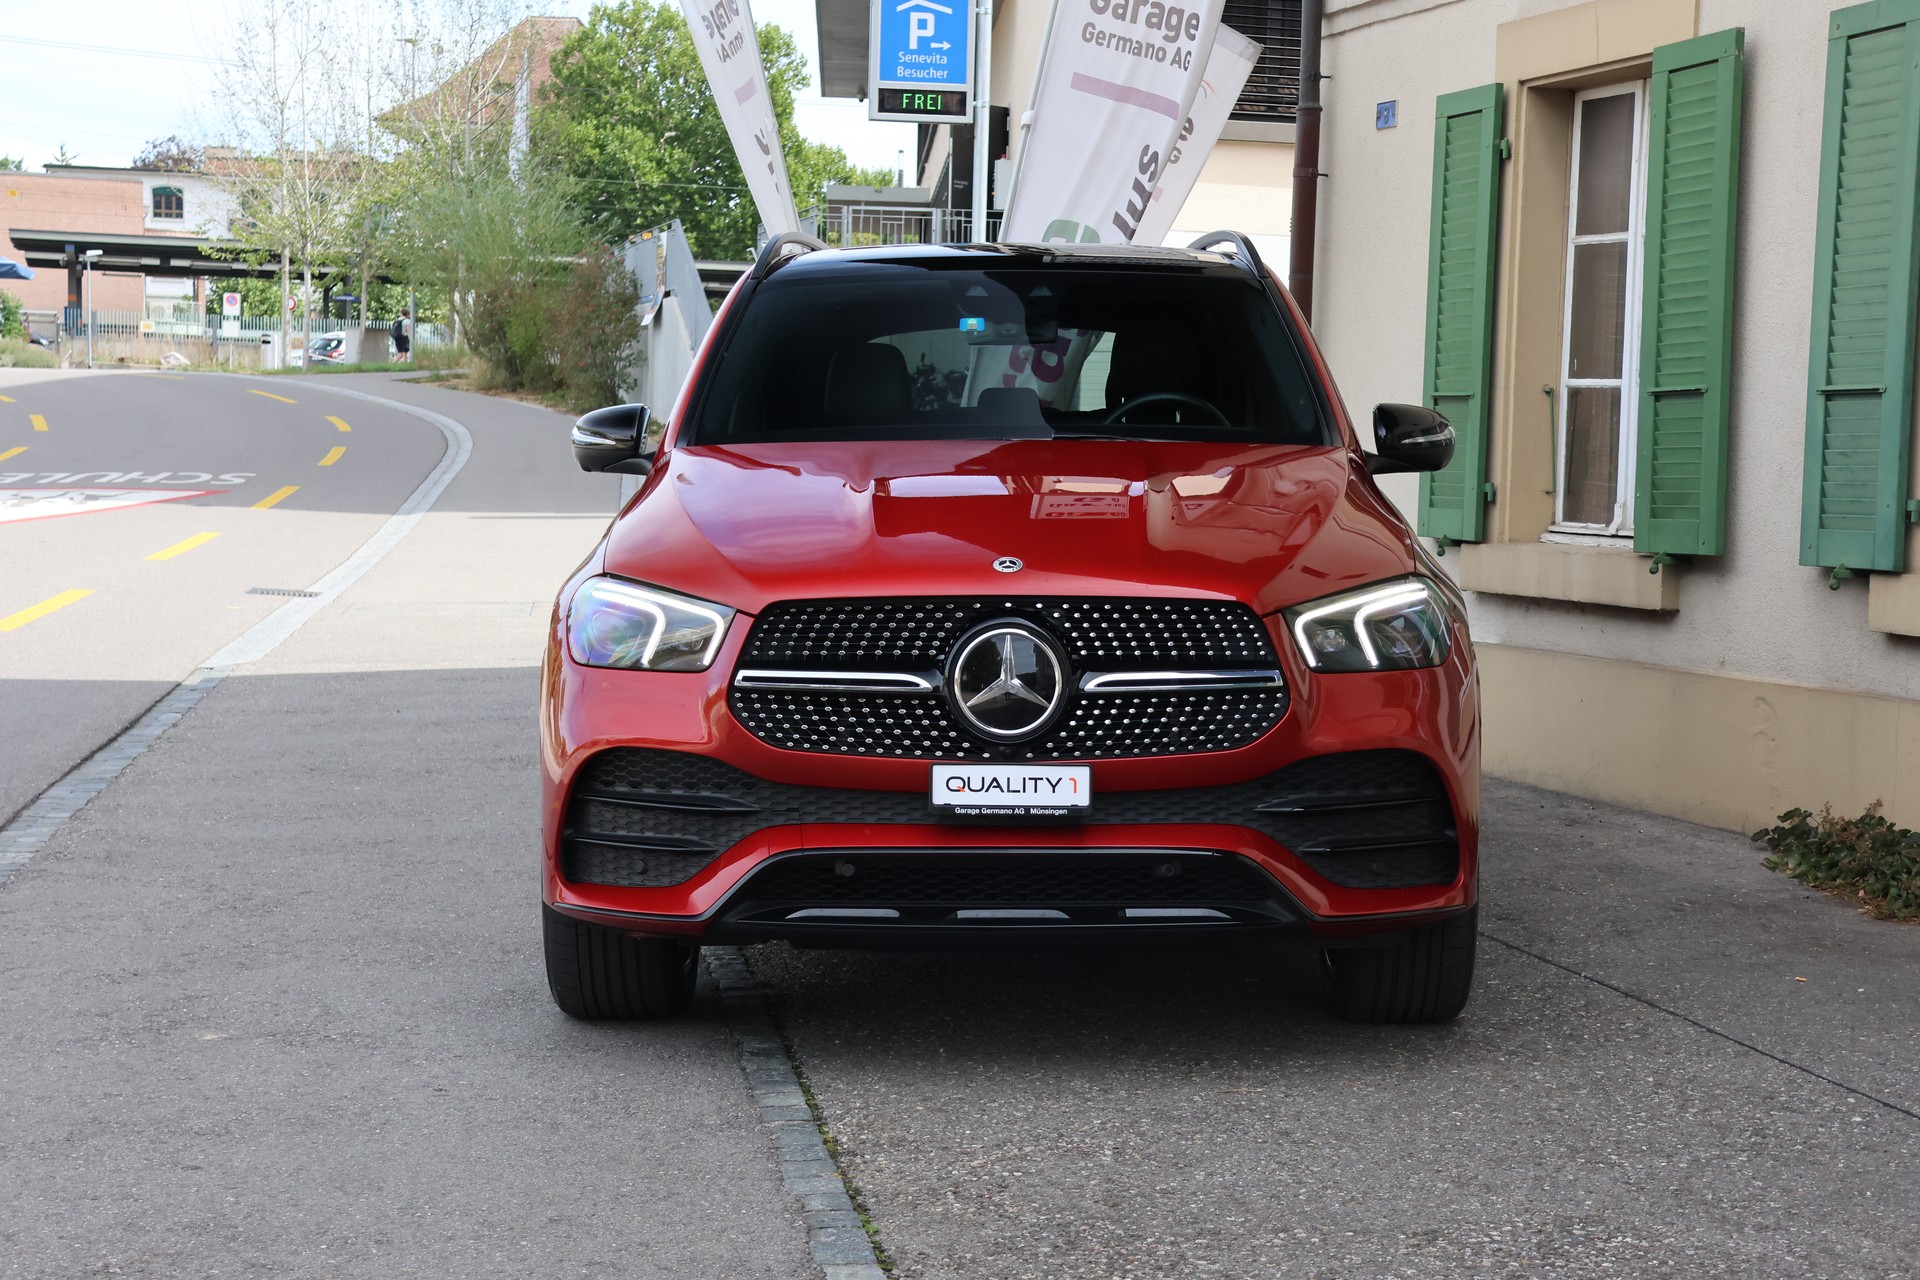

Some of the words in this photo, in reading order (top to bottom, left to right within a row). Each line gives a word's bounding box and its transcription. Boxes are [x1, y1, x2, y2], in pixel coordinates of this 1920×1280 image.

[909, 12, 935, 50] P
[1081, 22, 1167, 63] Germano
[1170, 46, 1192, 72] AG
[898, 51, 948, 65] Senevita
[897, 66, 949, 79] Besucher
[902, 93, 942, 110] FREI
[954, 807, 980, 815] Garage
[981, 807, 1012, 815] Germano
[1014, 807, 1025, 815] AG
[1030, 807, 1068, 816] Münsingen
